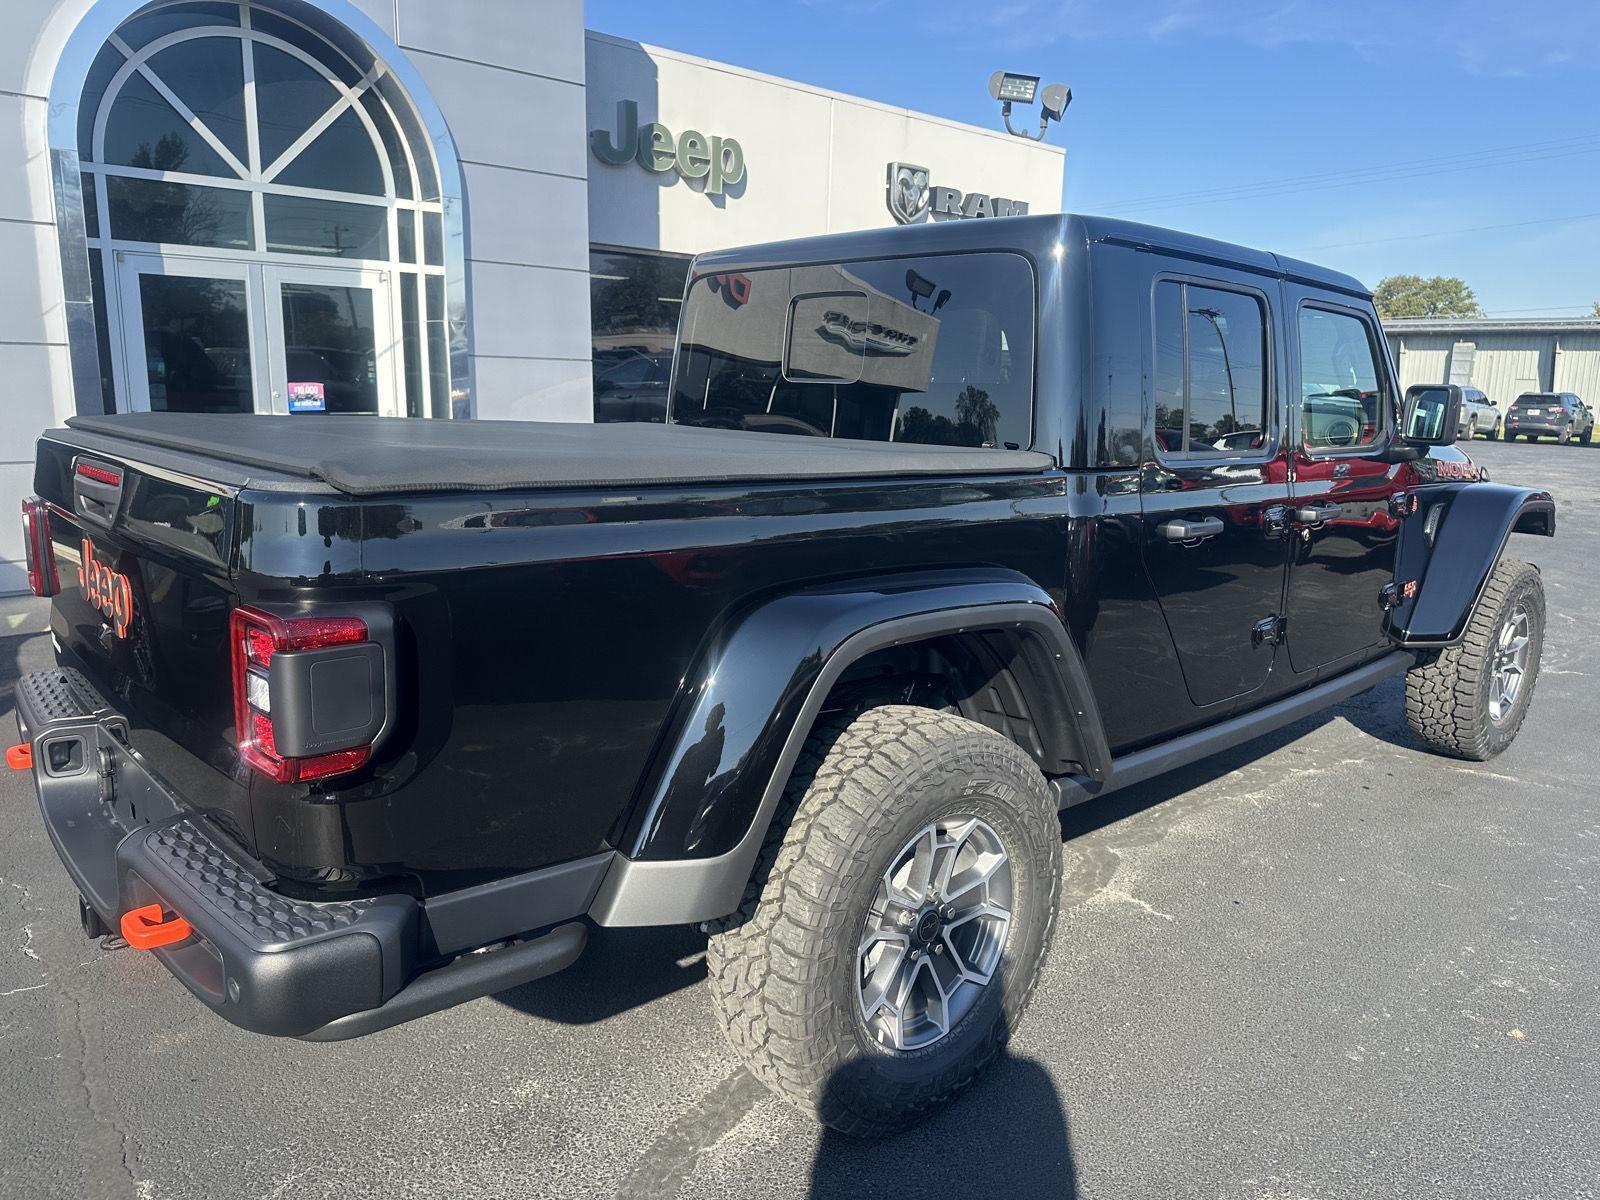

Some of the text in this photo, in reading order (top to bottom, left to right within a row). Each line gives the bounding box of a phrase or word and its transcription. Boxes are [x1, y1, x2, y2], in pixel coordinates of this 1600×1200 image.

[590, 99, 745, 195] Jeep
[929, 185, 1030, 218] RAM
[77, 536, 133, 639] Jeep
